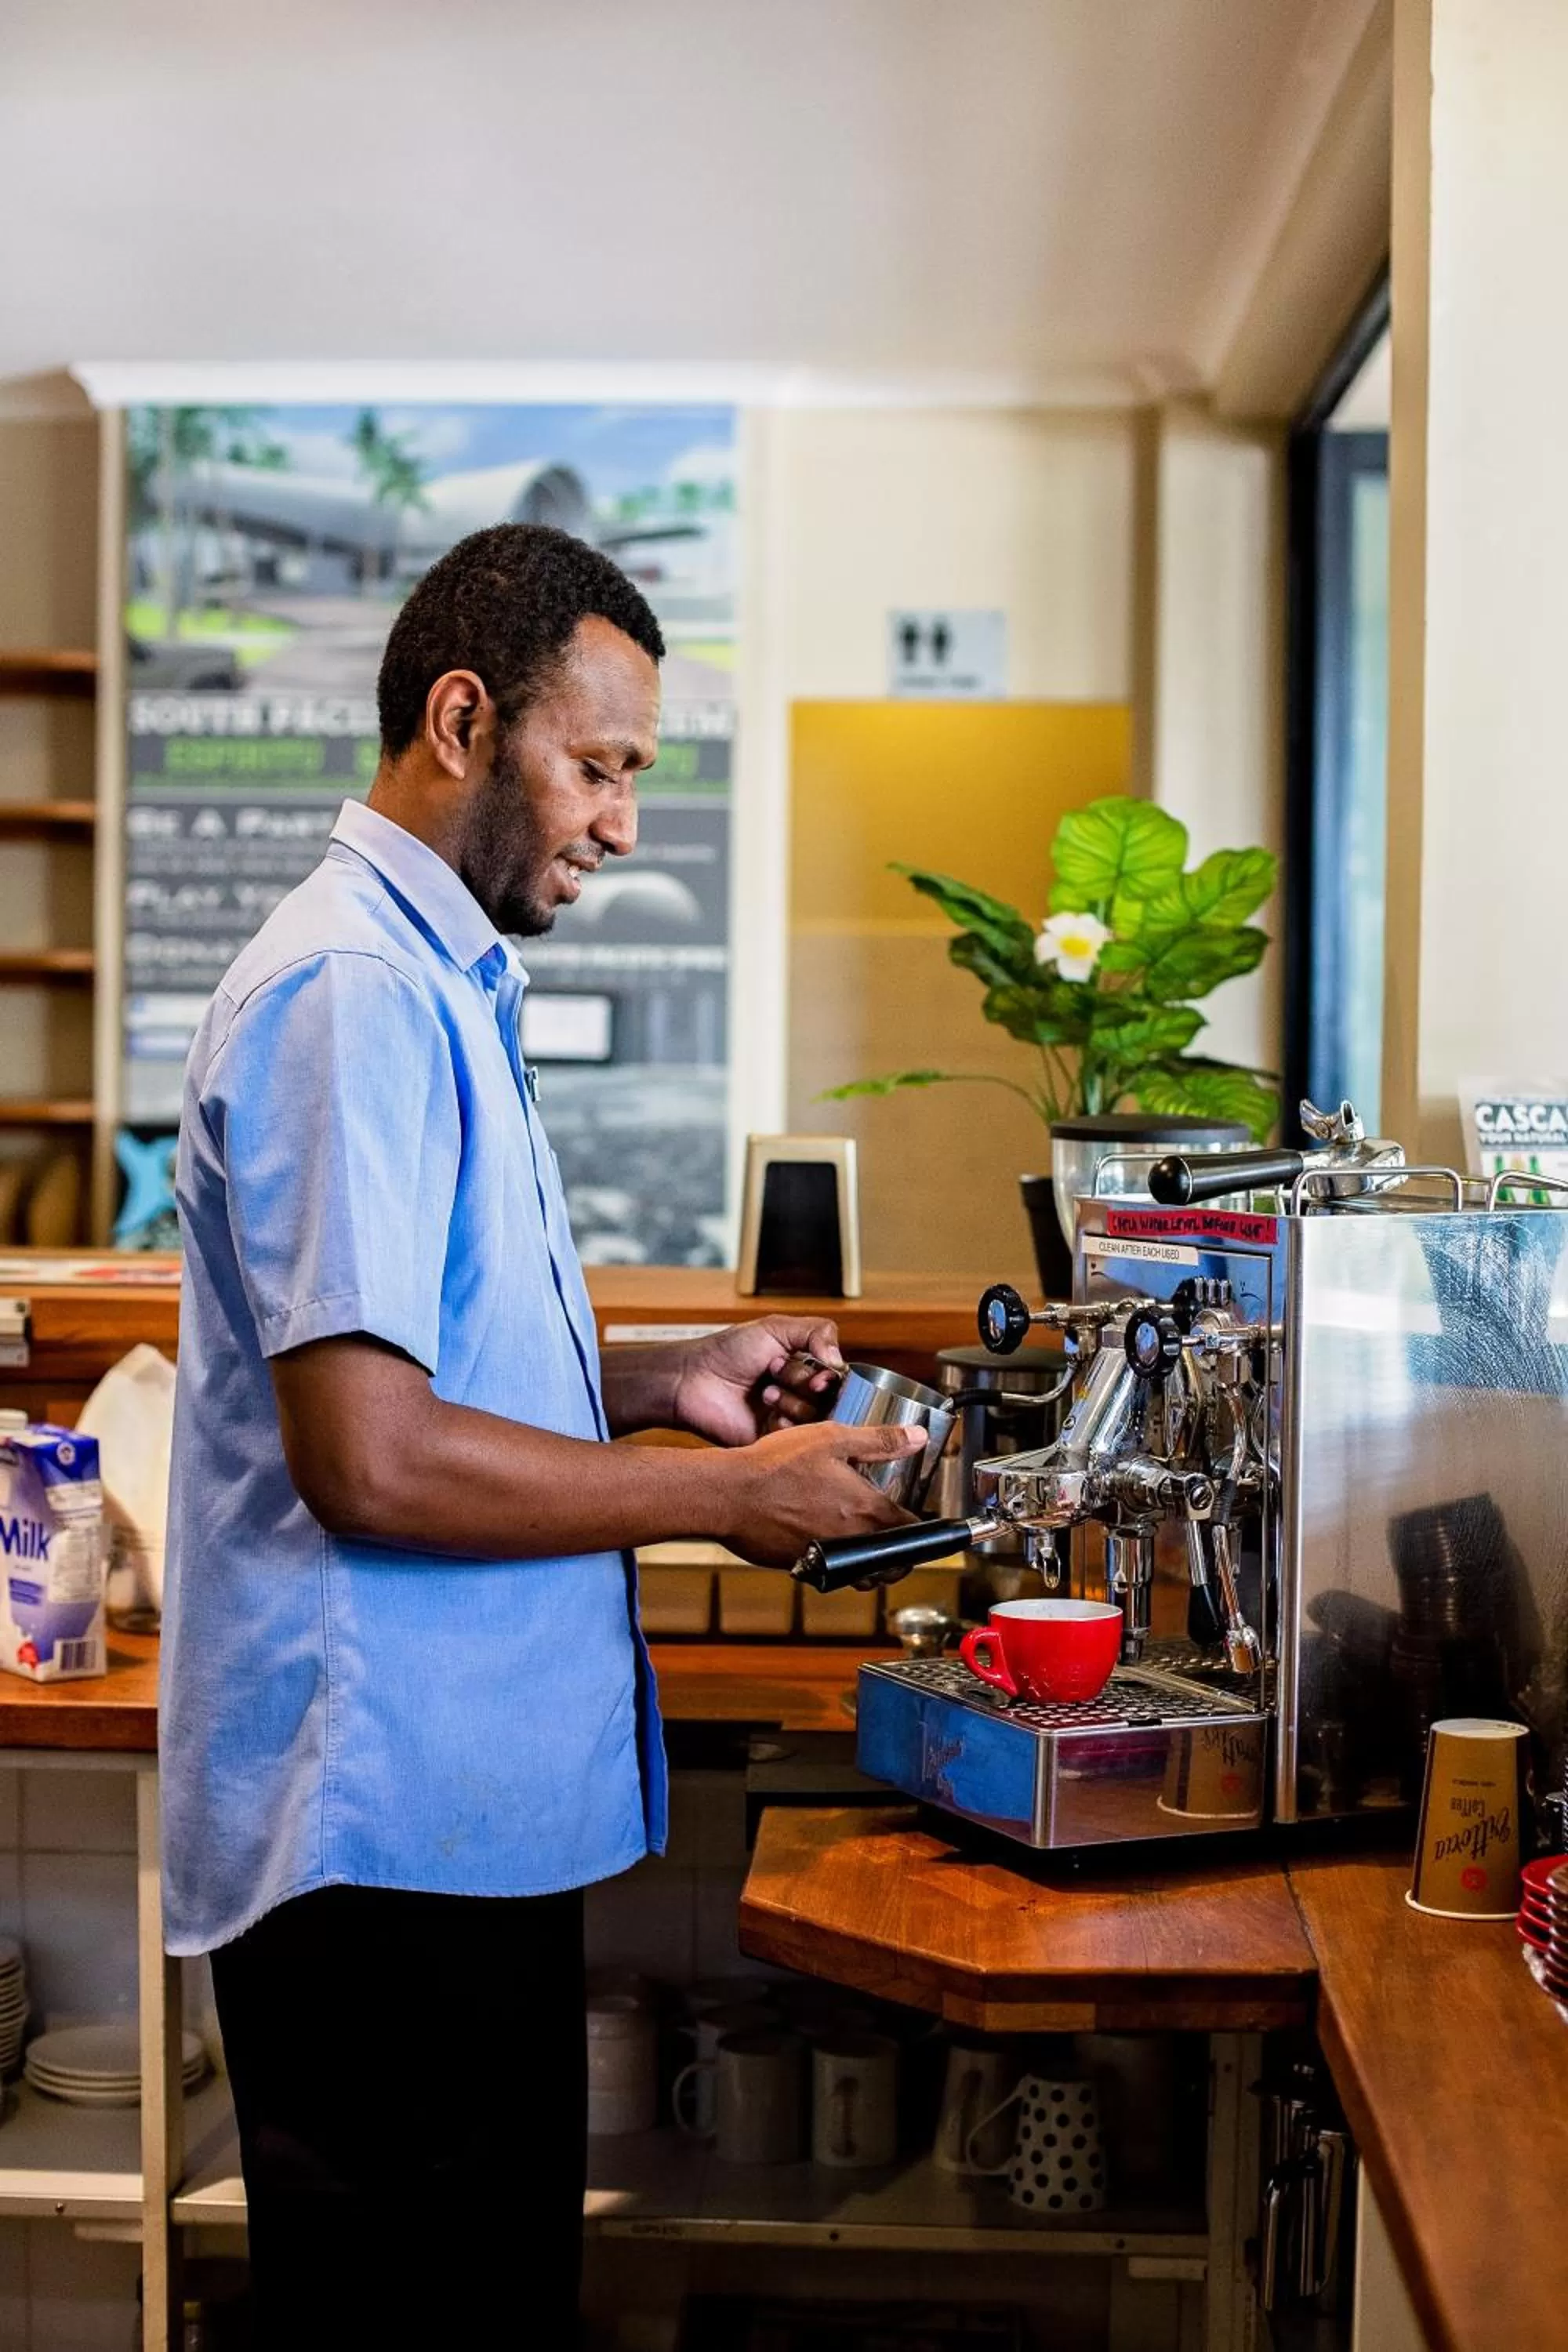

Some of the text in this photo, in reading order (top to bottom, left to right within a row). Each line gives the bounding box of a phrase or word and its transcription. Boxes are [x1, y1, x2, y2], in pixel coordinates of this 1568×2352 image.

[1475, 1103, 1568, 1133] CASCA
[1098, 1241, 1120, 1254] CLEAN
[1121, 1243, 1142, 1256] AFTER
[1143, 1246, 1161, 1258] EACH
[0, 1515, 51, 1562] Milk
[1451, 1796, 1486, 1819] Coffee
